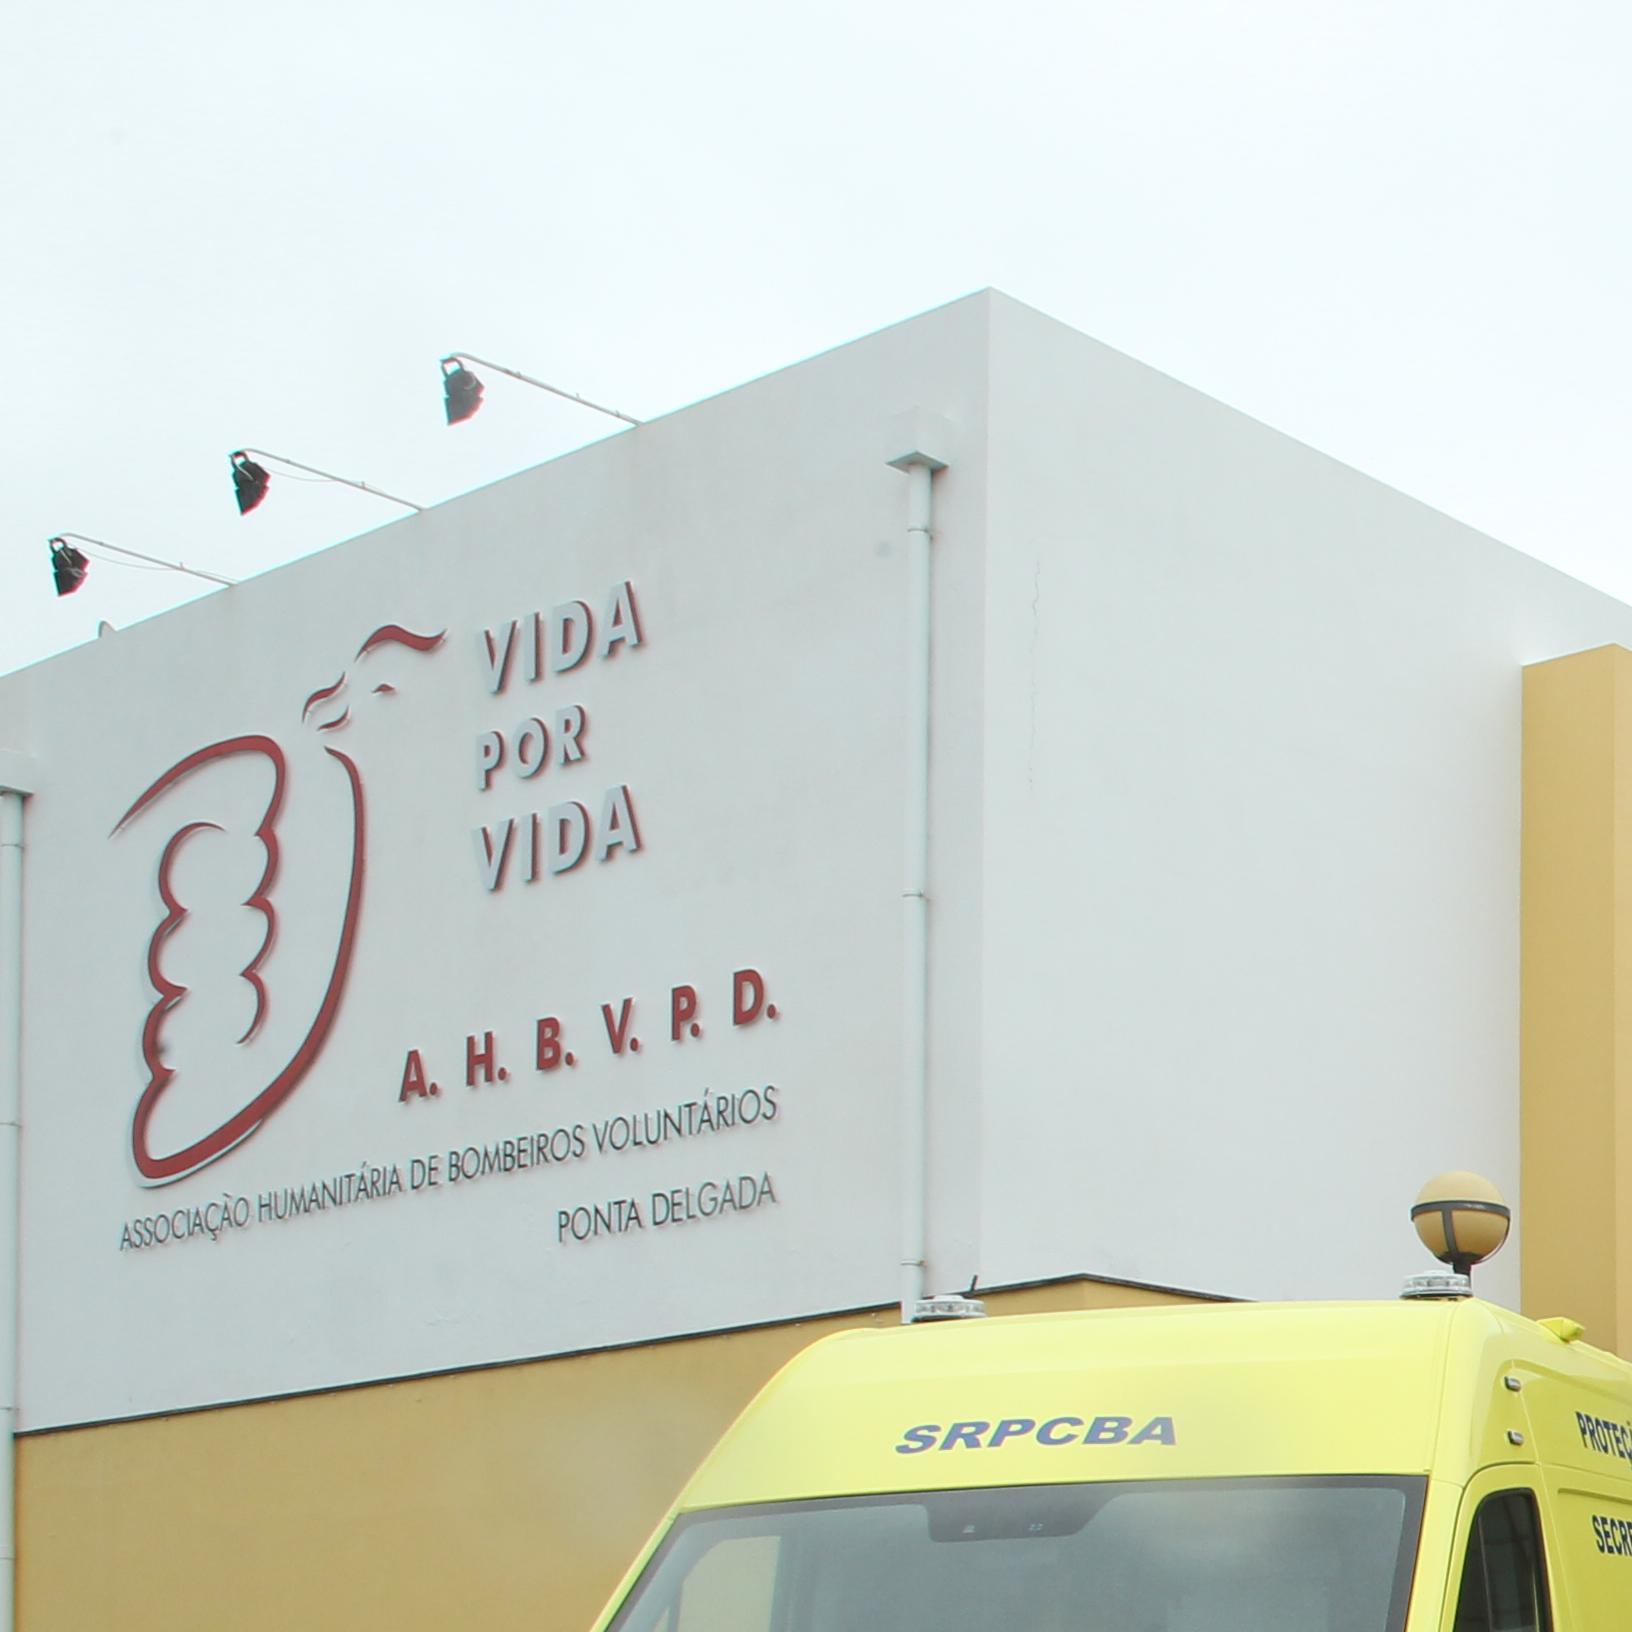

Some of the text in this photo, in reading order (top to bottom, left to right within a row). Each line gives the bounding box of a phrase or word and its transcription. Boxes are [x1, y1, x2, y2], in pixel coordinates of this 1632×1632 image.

[476, 580, 645, 695] VIDA
[476, 703, 590, 792] POR
[472, 784, 643, 893] VIDA
[119, 1085, 778, 1251] ASSOCIAÇÃO HUMANITÁRIA DE BOMBEIROS VOLUNTÁRIOS
[558, 1171, 777, 1243] PONTA DELGADA
[894, 1415, 1177, 1454] SRPCBA
